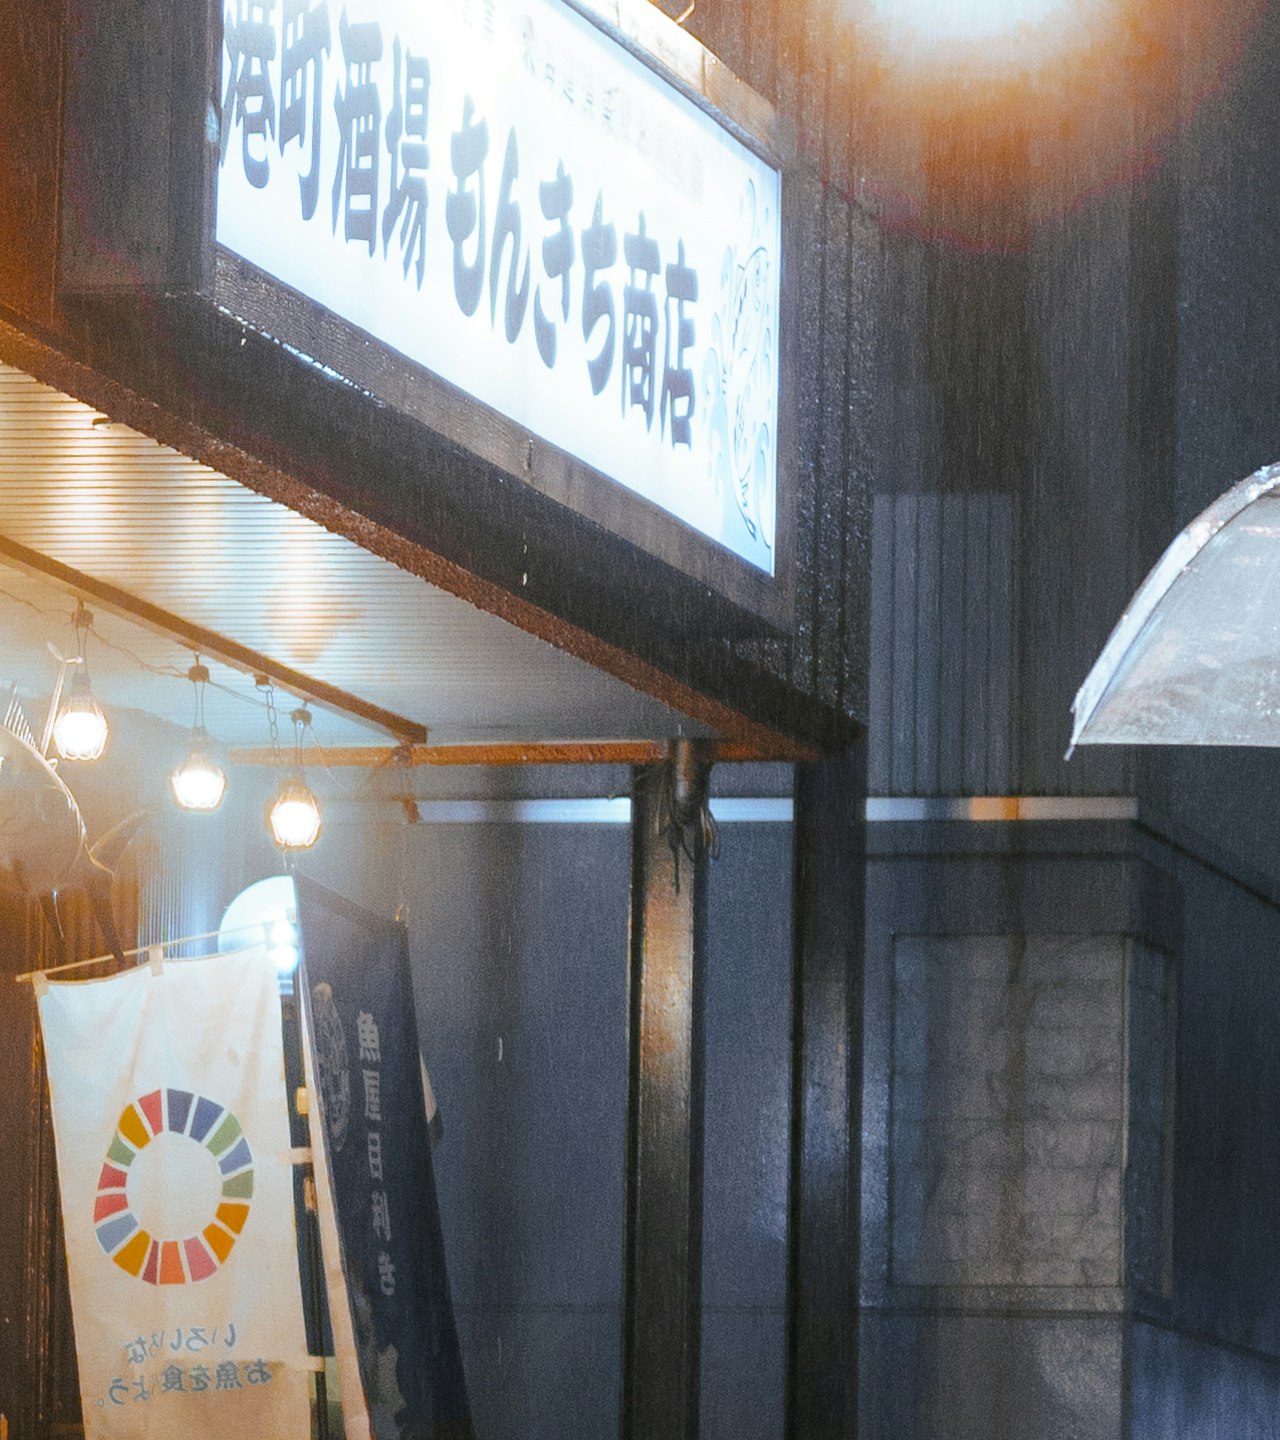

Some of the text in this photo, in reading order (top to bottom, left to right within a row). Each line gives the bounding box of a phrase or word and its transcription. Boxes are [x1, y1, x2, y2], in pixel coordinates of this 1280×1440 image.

[445, 95, 701, 449] もんきち商店
